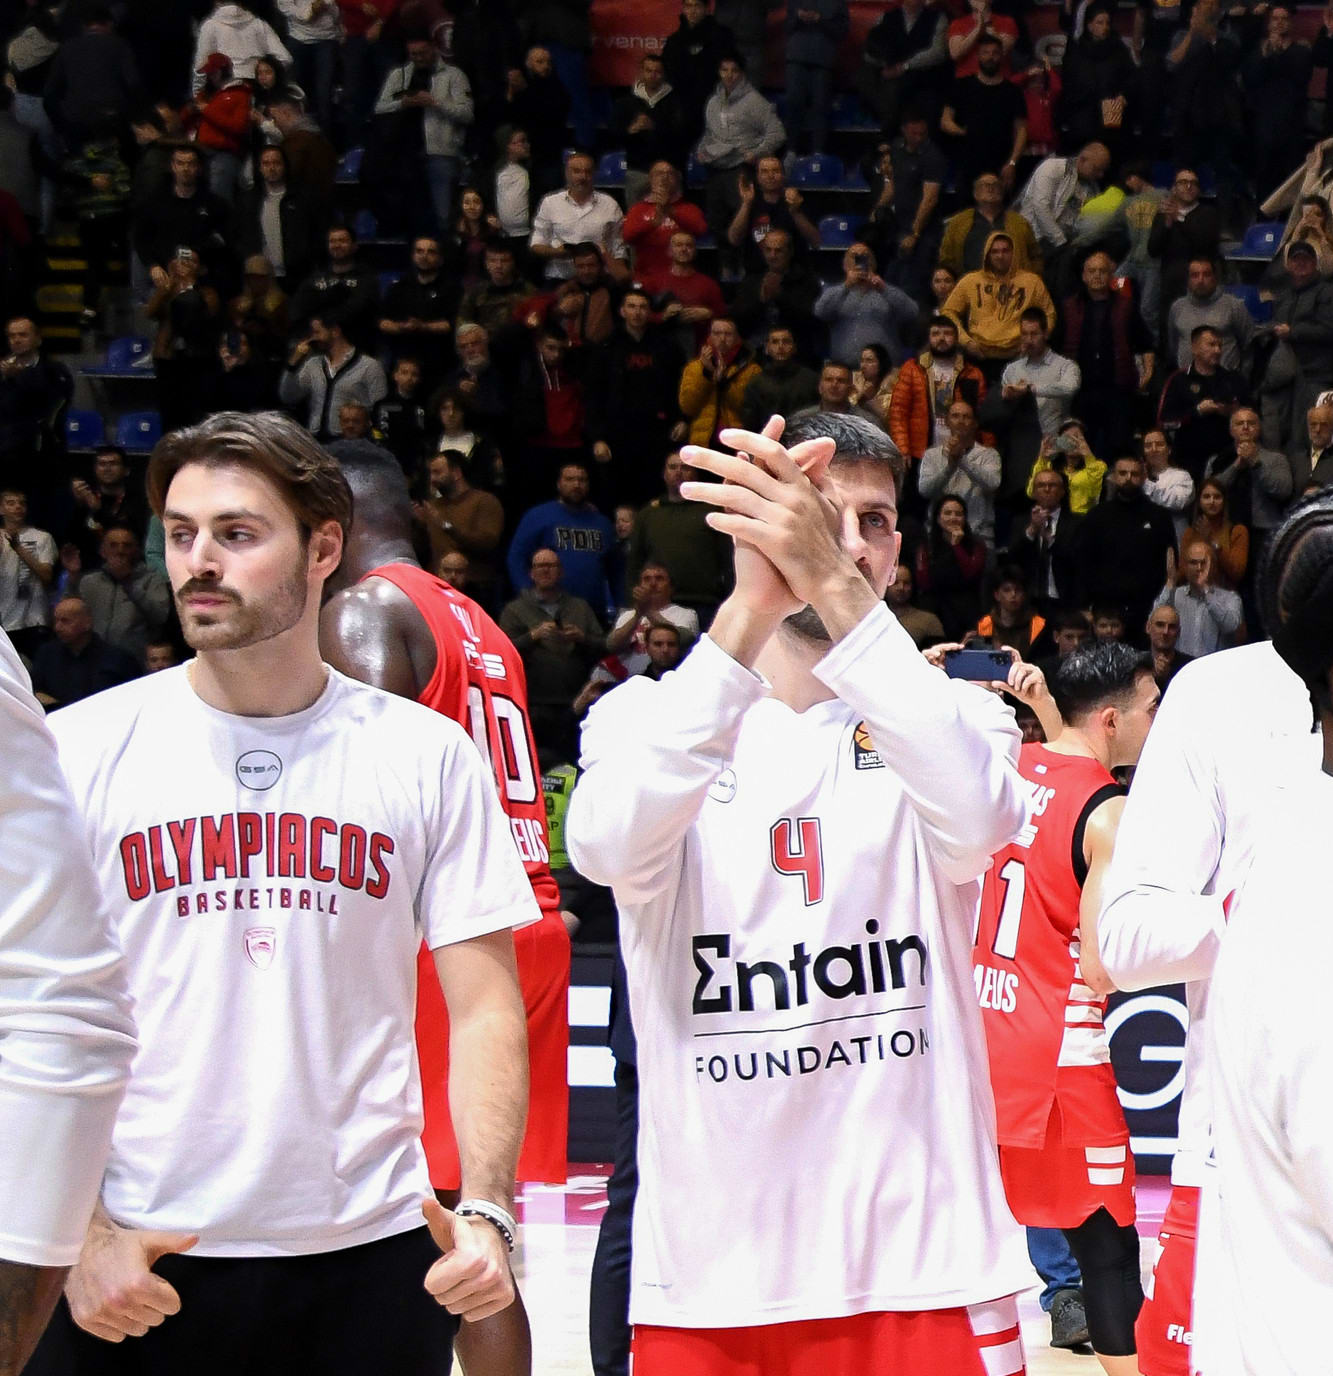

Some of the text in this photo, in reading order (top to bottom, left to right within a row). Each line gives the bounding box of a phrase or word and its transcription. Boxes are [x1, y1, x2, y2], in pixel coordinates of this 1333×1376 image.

[119, 811, 395, 902] OLYMPIACOS
[176, 882, 339, 918] BASKETBALL
[769, 817, 824, 907] 4
